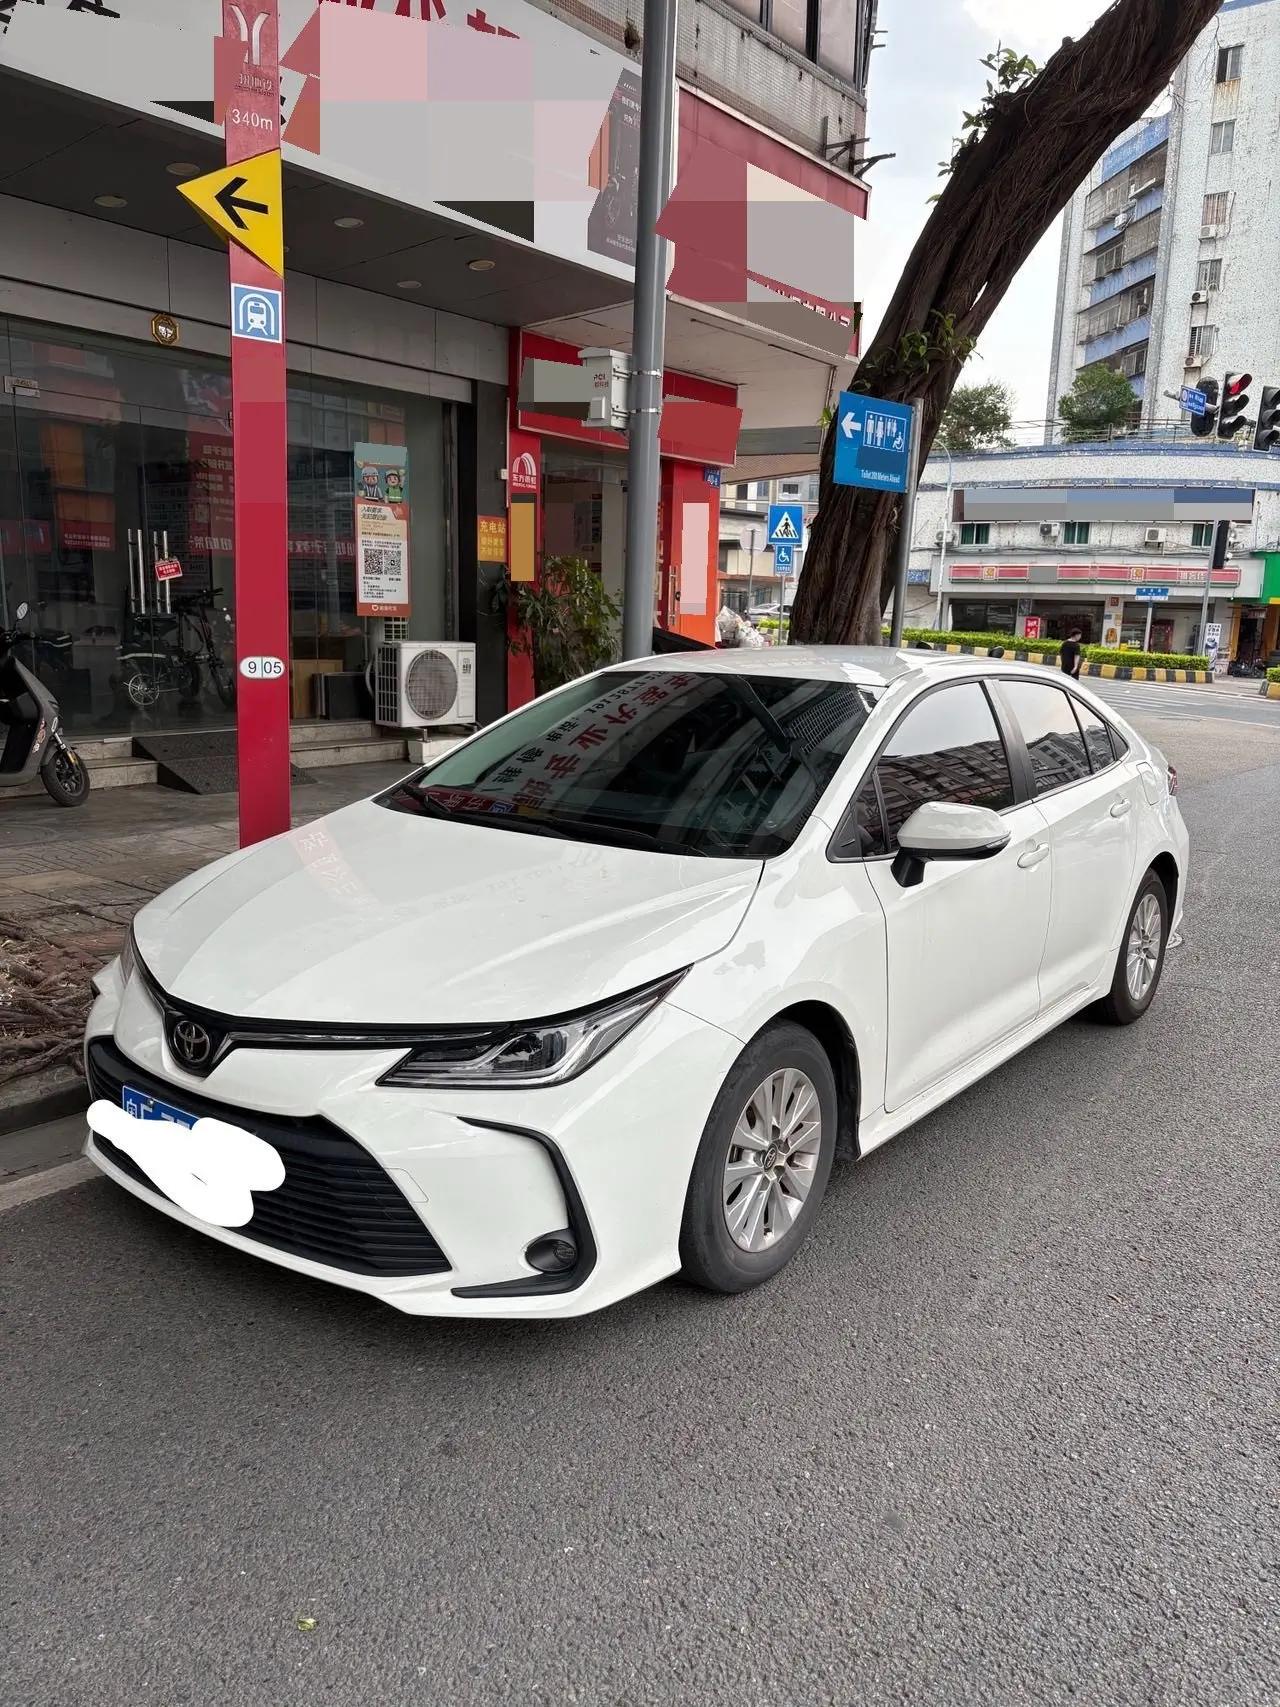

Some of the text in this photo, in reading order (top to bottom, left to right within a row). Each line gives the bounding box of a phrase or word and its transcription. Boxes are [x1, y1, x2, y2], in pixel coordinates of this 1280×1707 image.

[231, 108, 273, 131] 340m
[248, 661, 282, 674] 9 05
